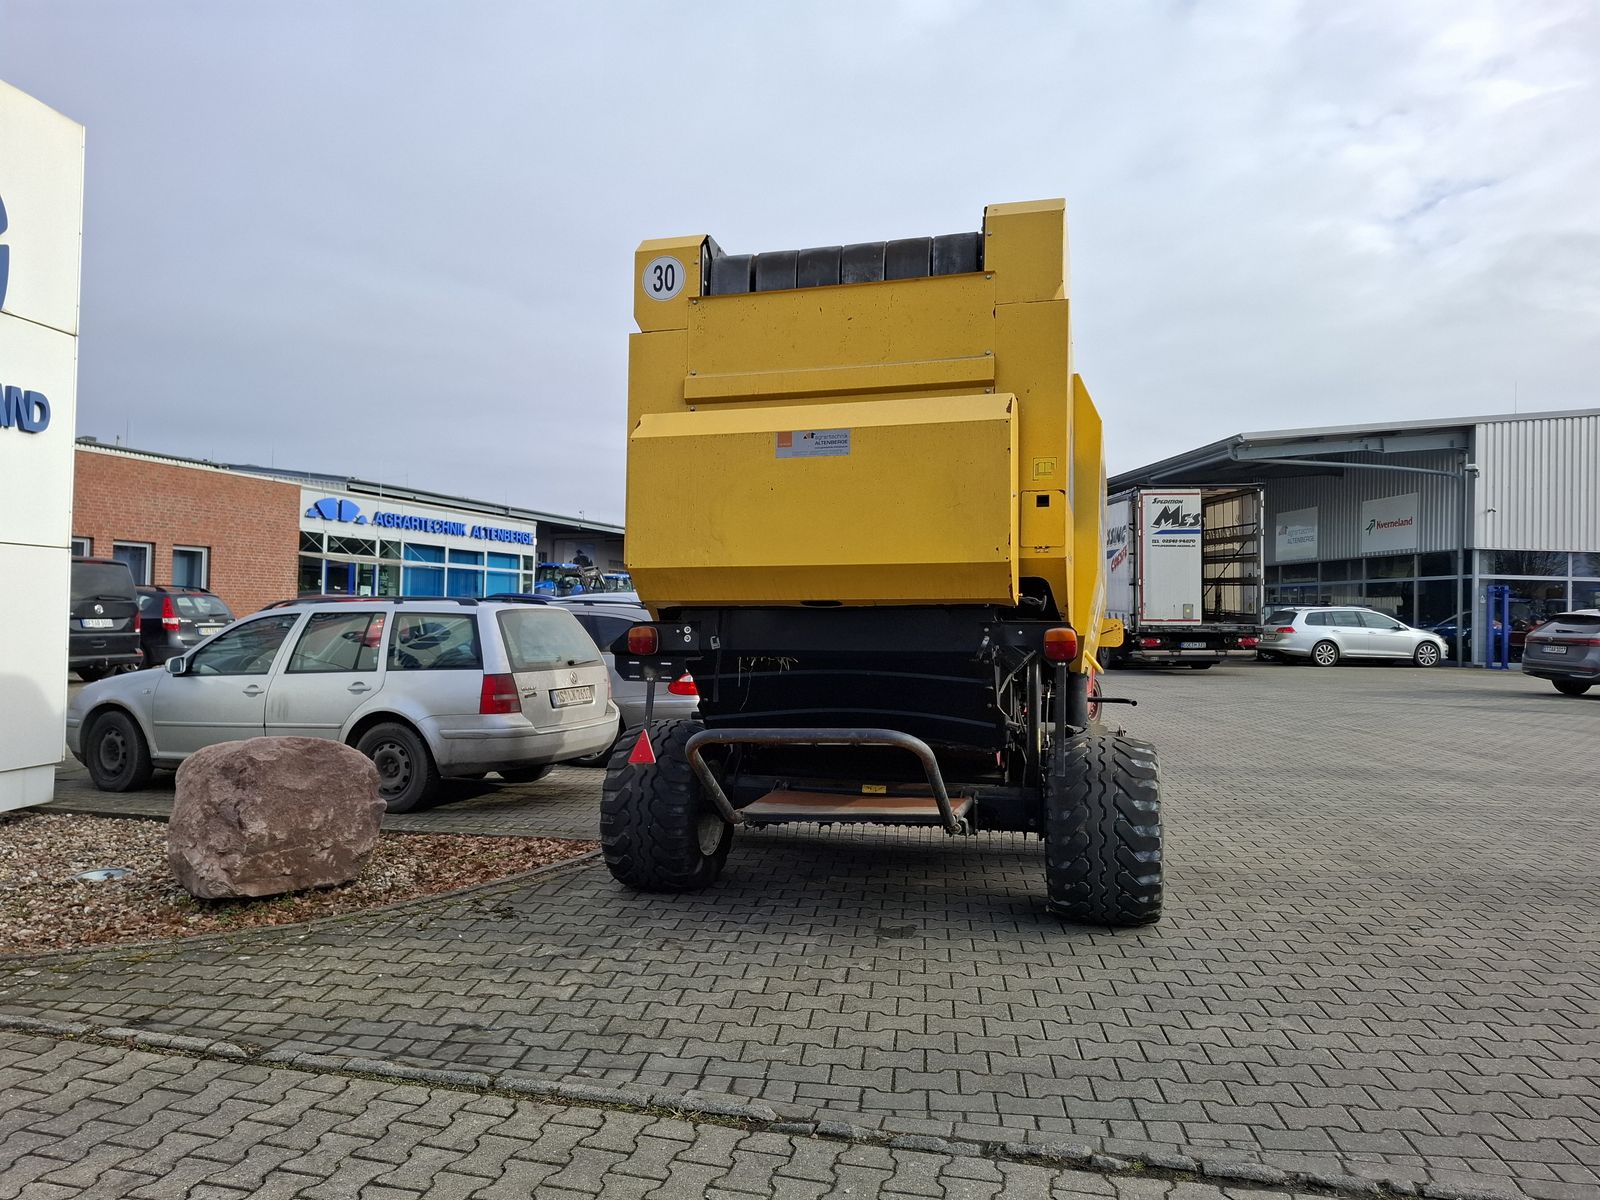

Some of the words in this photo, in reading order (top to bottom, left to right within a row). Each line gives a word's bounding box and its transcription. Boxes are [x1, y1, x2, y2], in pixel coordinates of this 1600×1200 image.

[653, 264, 675, 292] 30
[373, 511, 467, 537] AGRARTECHNIK
[470, 525, 534, 545] ALTENBERGE
[1376, 516, 1413, 530] Kverneland
